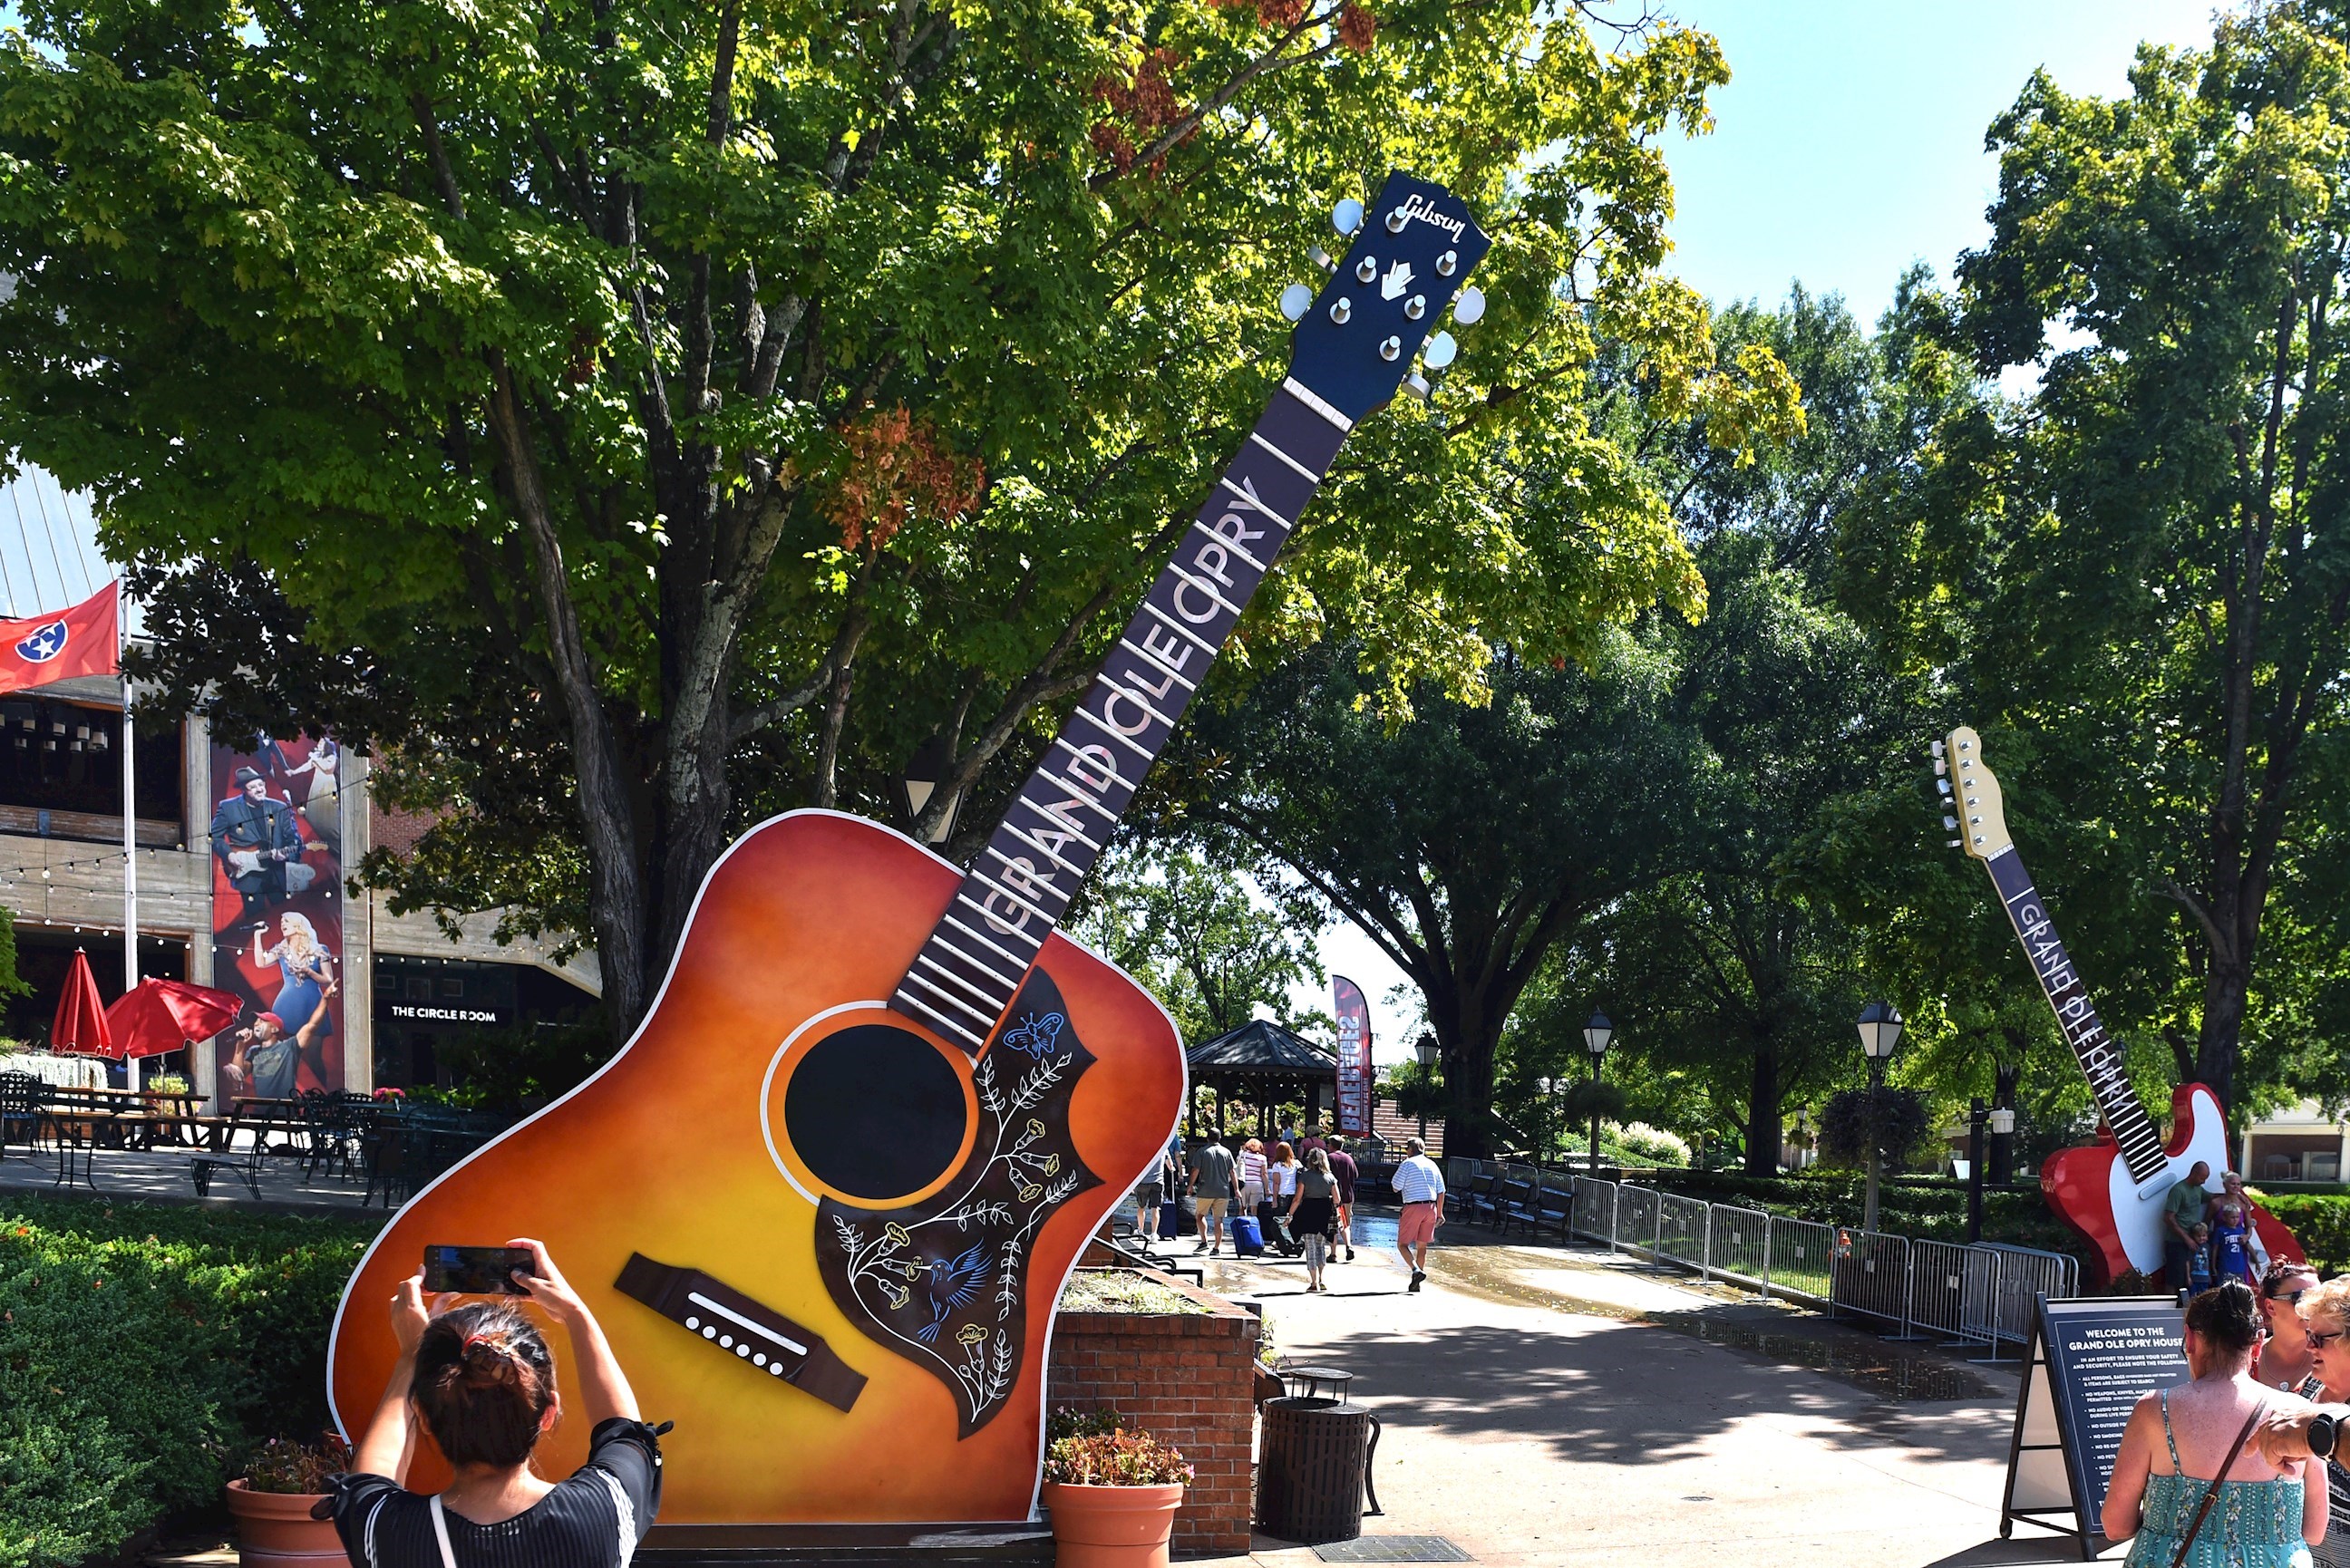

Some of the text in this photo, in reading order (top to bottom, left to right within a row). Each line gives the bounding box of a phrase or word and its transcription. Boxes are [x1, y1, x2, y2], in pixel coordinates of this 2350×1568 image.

[1402, 193, 1466, 244] Gibson
[983, 476, 1267, 935] GRAND OLE OPRY
[392, 1006, 496, 1022] THE CIRCLE ROOM
[2020, 904, 2073, 992] GRAND
[2089, 1049, 2132, 1111] OPRY
[2230, 1244, 2240, 1253] 21
[2085, 1327, 2164, 1339] WELCOME TO THE
[2069, 1341, 2104, 1350] GRAND
[2105, 1340, 2125, 1350] OLE
[2126, 1339, 2151, 1348] OPRY
